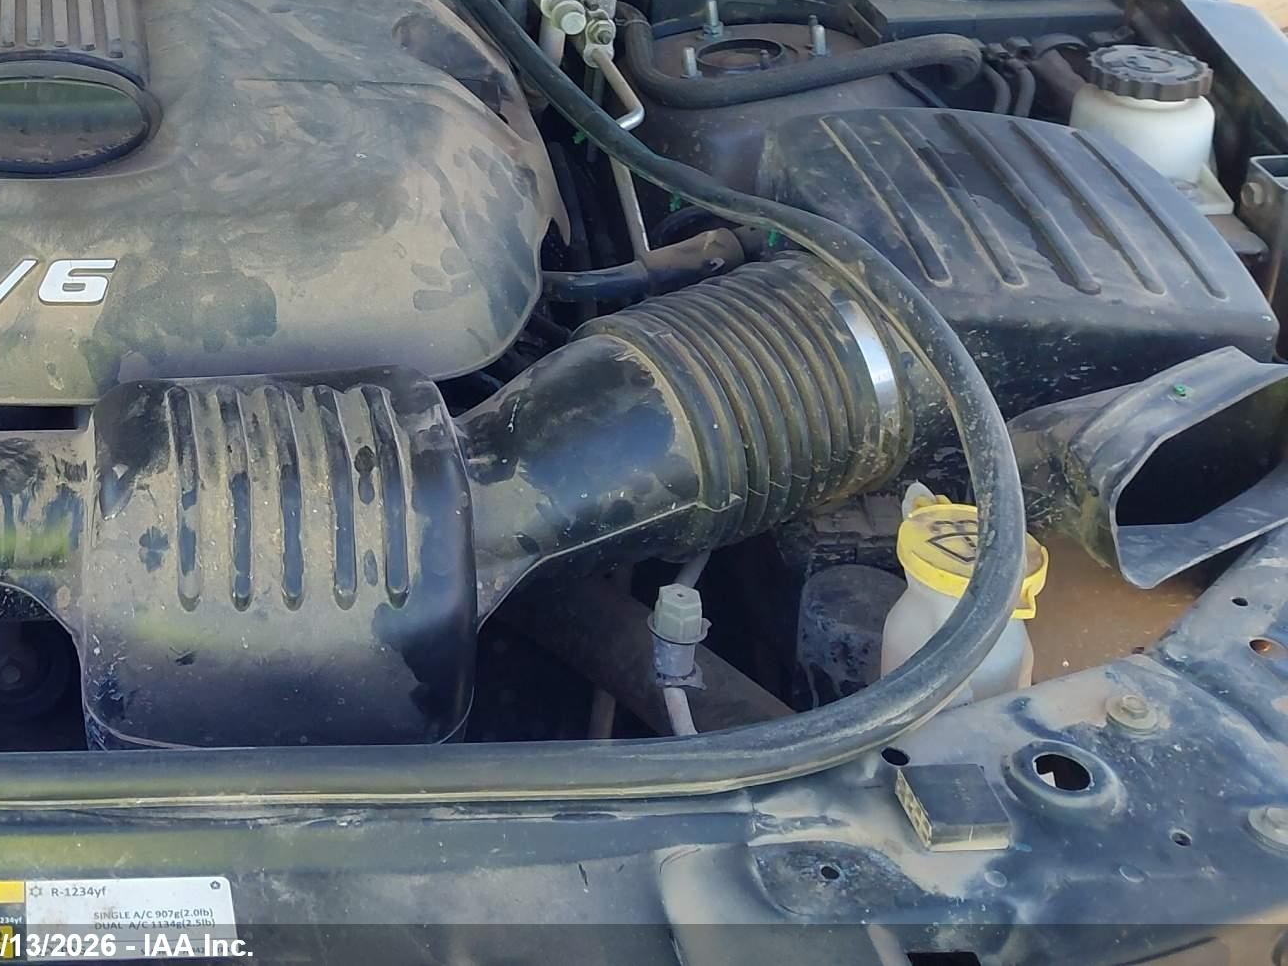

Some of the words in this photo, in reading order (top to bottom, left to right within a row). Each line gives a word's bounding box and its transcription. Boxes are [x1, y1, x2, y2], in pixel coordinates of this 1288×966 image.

[51, 886, 106, 898] R-1234yf
[94, 911, 130, 920] SINGLE
[133, 910, 153, 919] A/C
[155, 908, 213, 919] 907g(2.0lb)
[95, 921, 123, 930] DUAL
[129, 920, 149, 930] A/C
[151, 918, 215, 929] 1134g(2.5lb)
